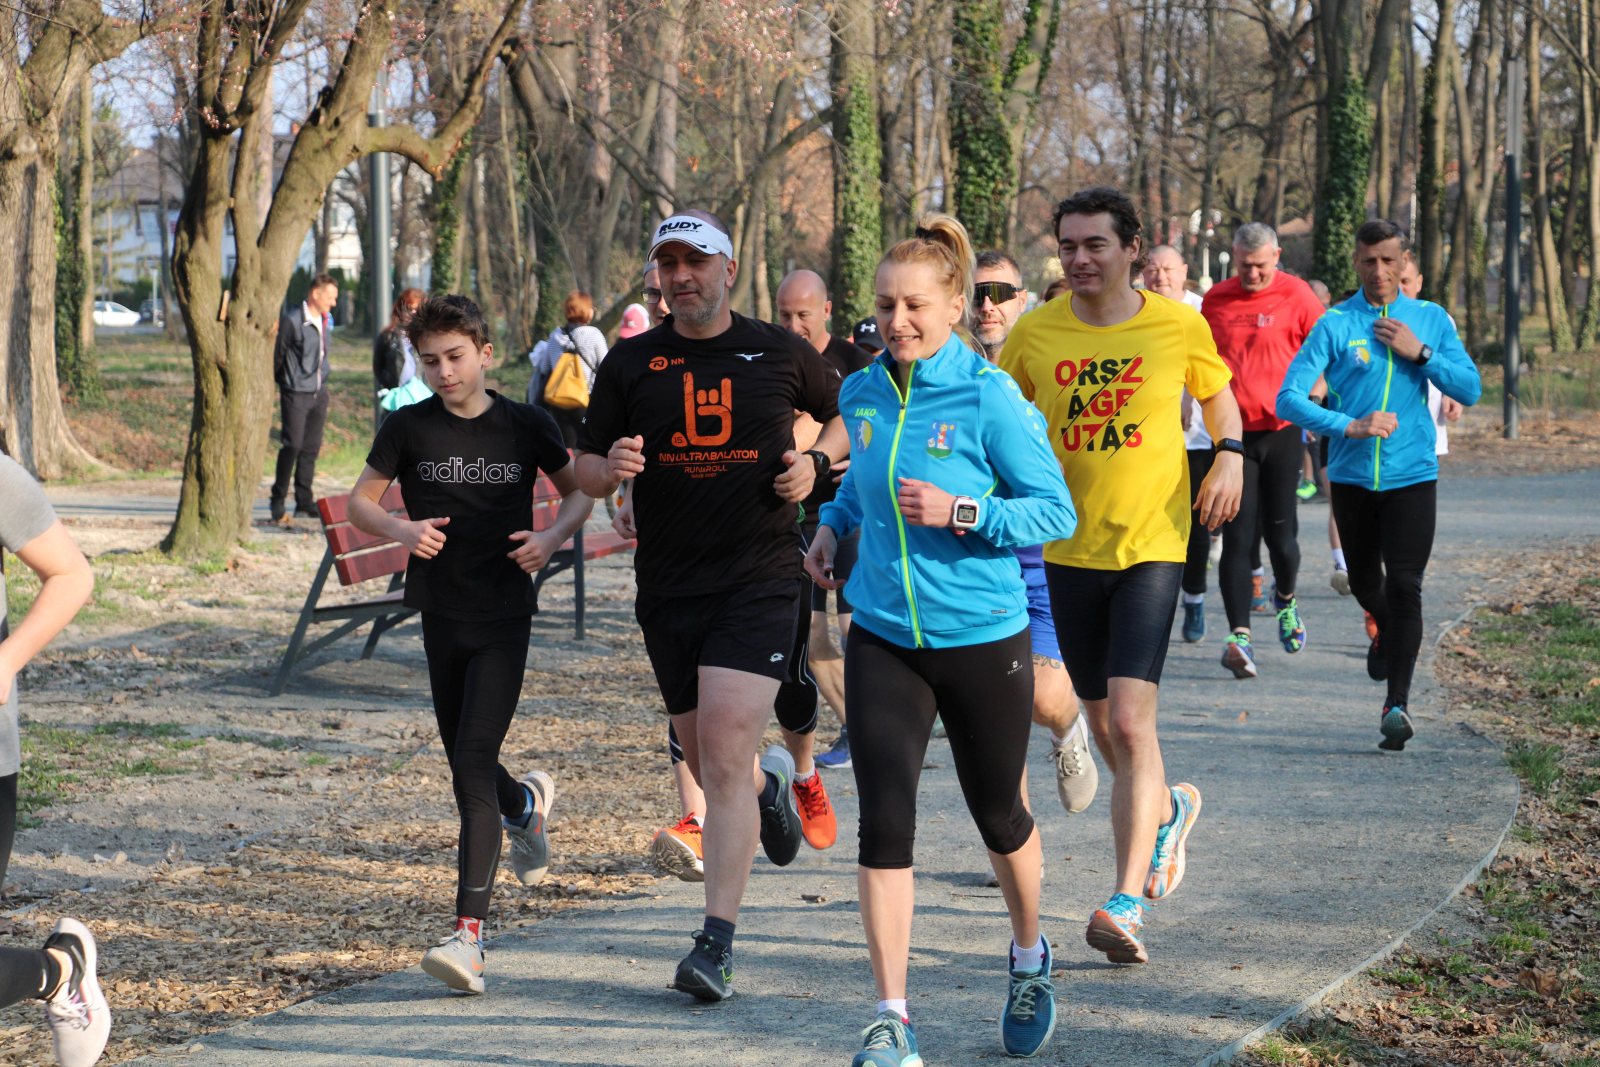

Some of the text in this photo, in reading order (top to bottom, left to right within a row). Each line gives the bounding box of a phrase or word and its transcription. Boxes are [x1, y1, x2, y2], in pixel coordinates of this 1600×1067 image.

[659, 222, 702, 233] RUDY
[671, 357, 684, 366] NN
[1055, 357, 1143, 386] ORSZ
[854, 408, 877, 417] JAKO
[1061, 419, 1142, 451] UTÁS
[417, 457, 522, 483] adidas
